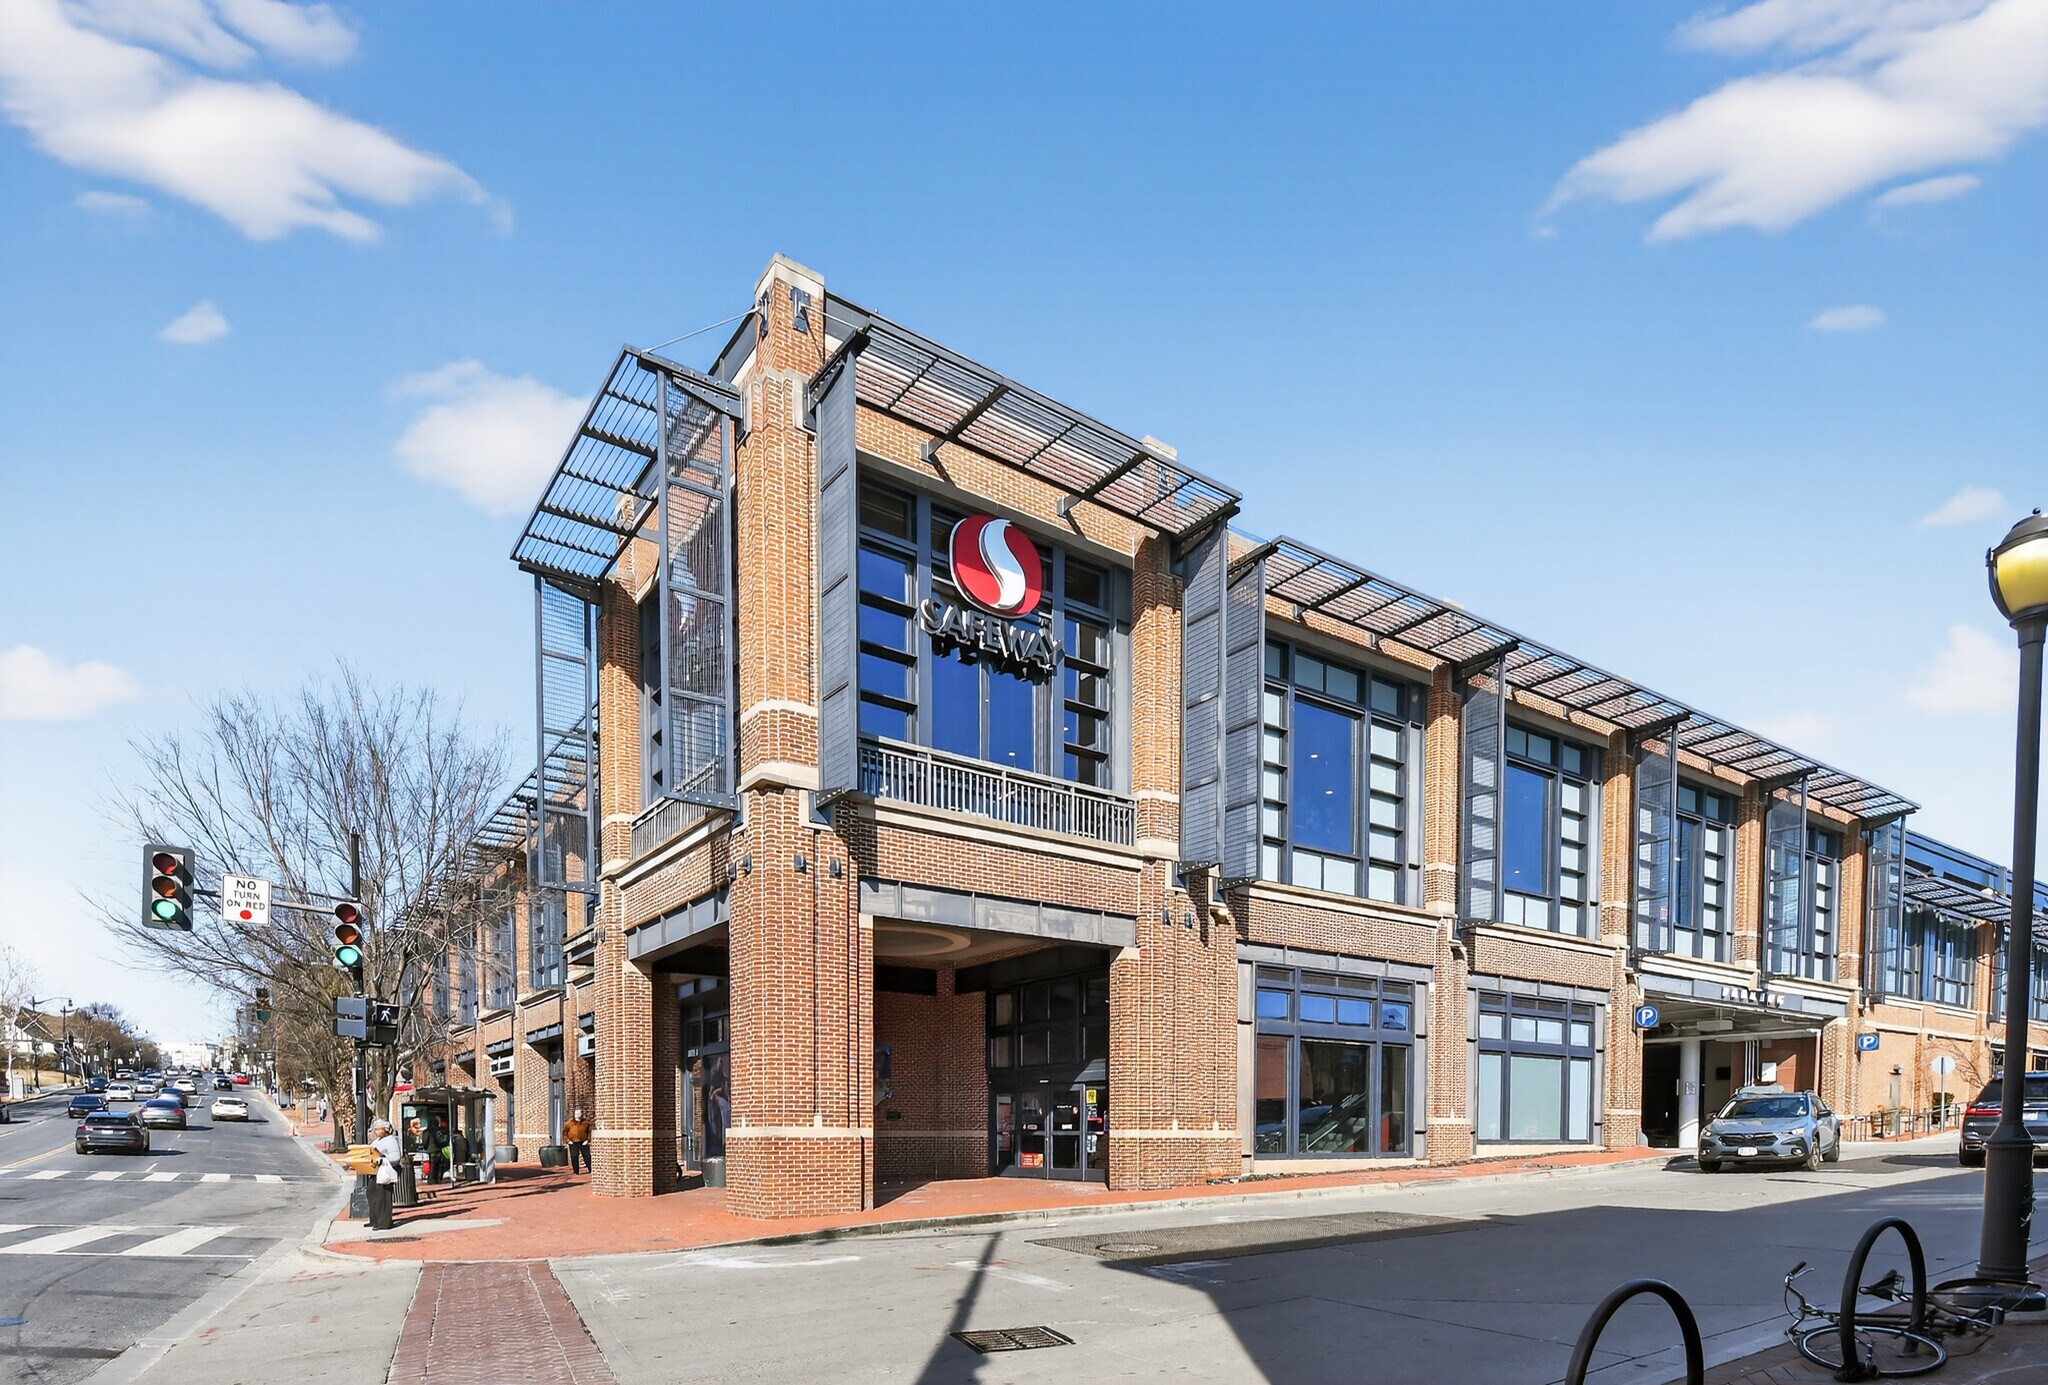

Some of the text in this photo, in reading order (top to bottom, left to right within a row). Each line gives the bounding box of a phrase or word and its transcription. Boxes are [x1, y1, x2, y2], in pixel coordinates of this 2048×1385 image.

[920, 598, 1064, 676] SAFEWAY
[236, 879, 257, 891] NO
[233, 890, 260, 900] TURN
[226, 898, 241, 908] ON
[1641, 1008, 1654, 1025] P
[1863, 1035, 1875, 1049] P
